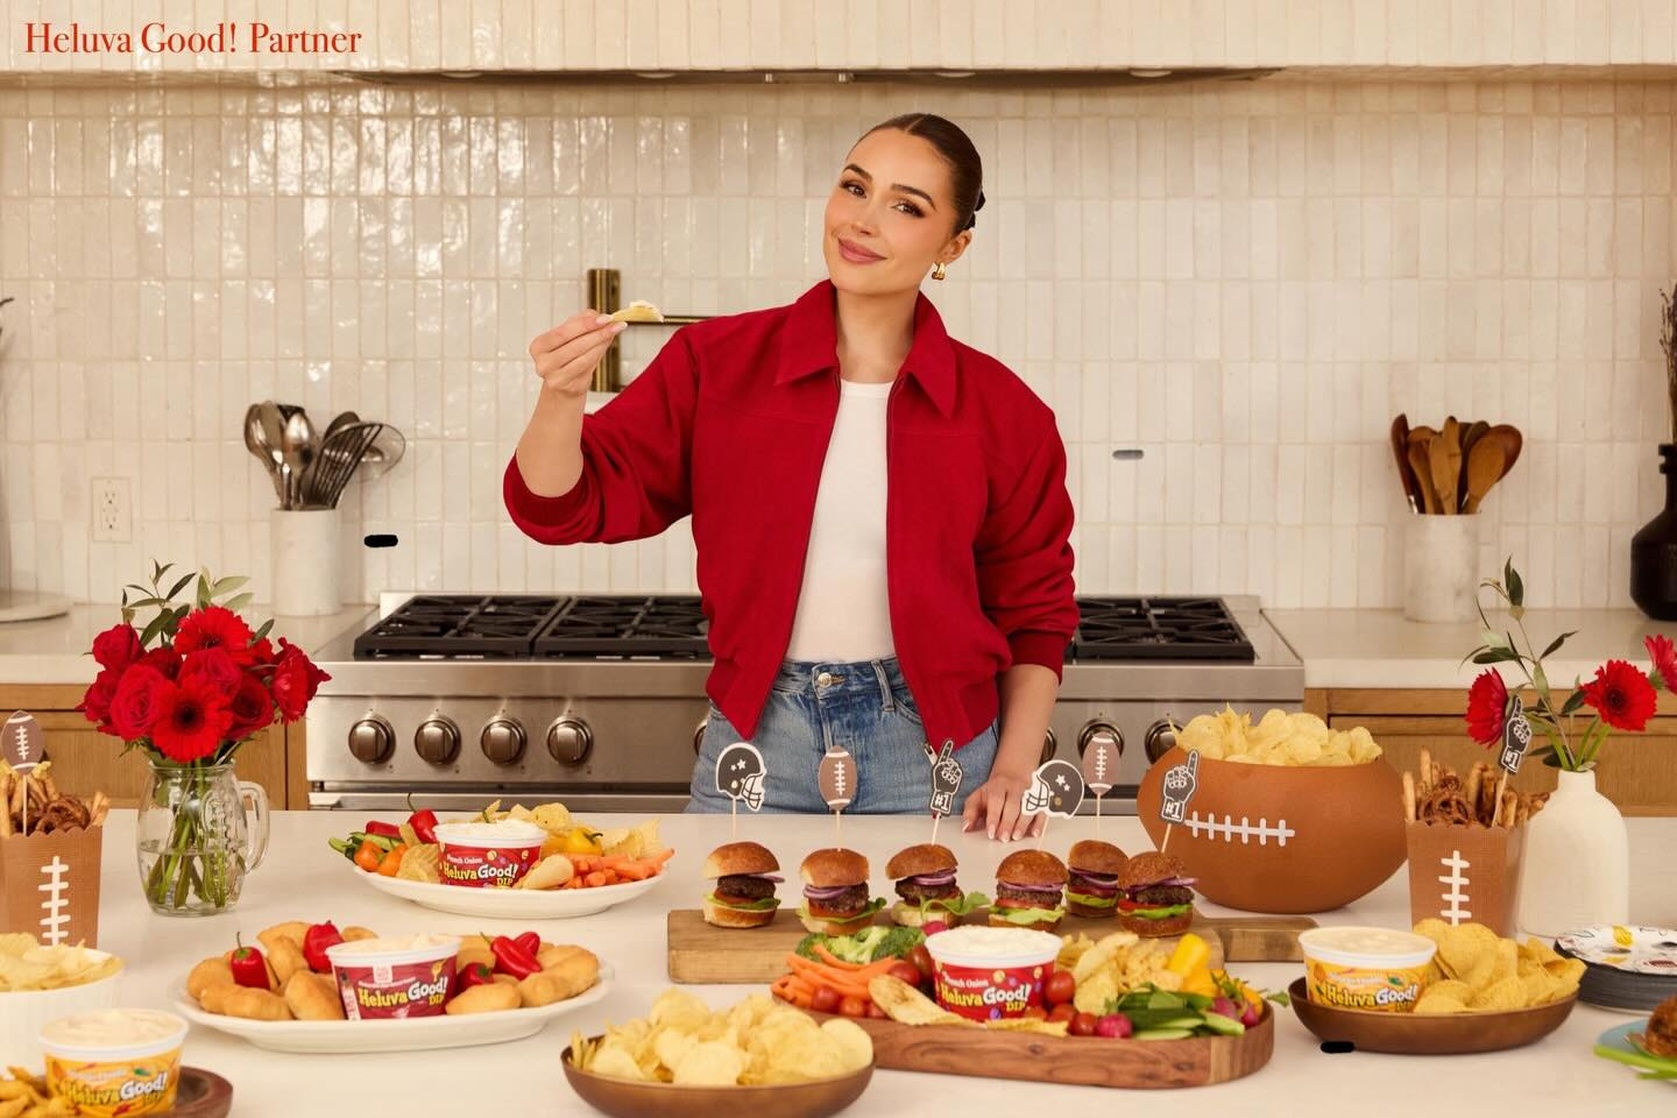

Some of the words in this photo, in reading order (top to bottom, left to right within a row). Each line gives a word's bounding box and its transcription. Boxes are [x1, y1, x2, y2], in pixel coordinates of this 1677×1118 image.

[934, 794, 949, 811] #1
[1165, 801, 1180, 819] #1
[443, 861, 478, 880] Heluva
[477, 863, 519, 879] Good!
[496, 877, 514, 886] DIP
[357, 987, 409, 1007] Heluva
[408, 976, 448, 1000] Good!
[940, 983, 983, 1006] Heluva
[983, 983, 1032, 1005] Good!
[1326, 983, 1376, 1006] Heluva
[1376, 983, 1418, 1005] Good!
[1006, 1001, 1026, 1012] DIP
[120, 1071, 168, 1100] Good!
